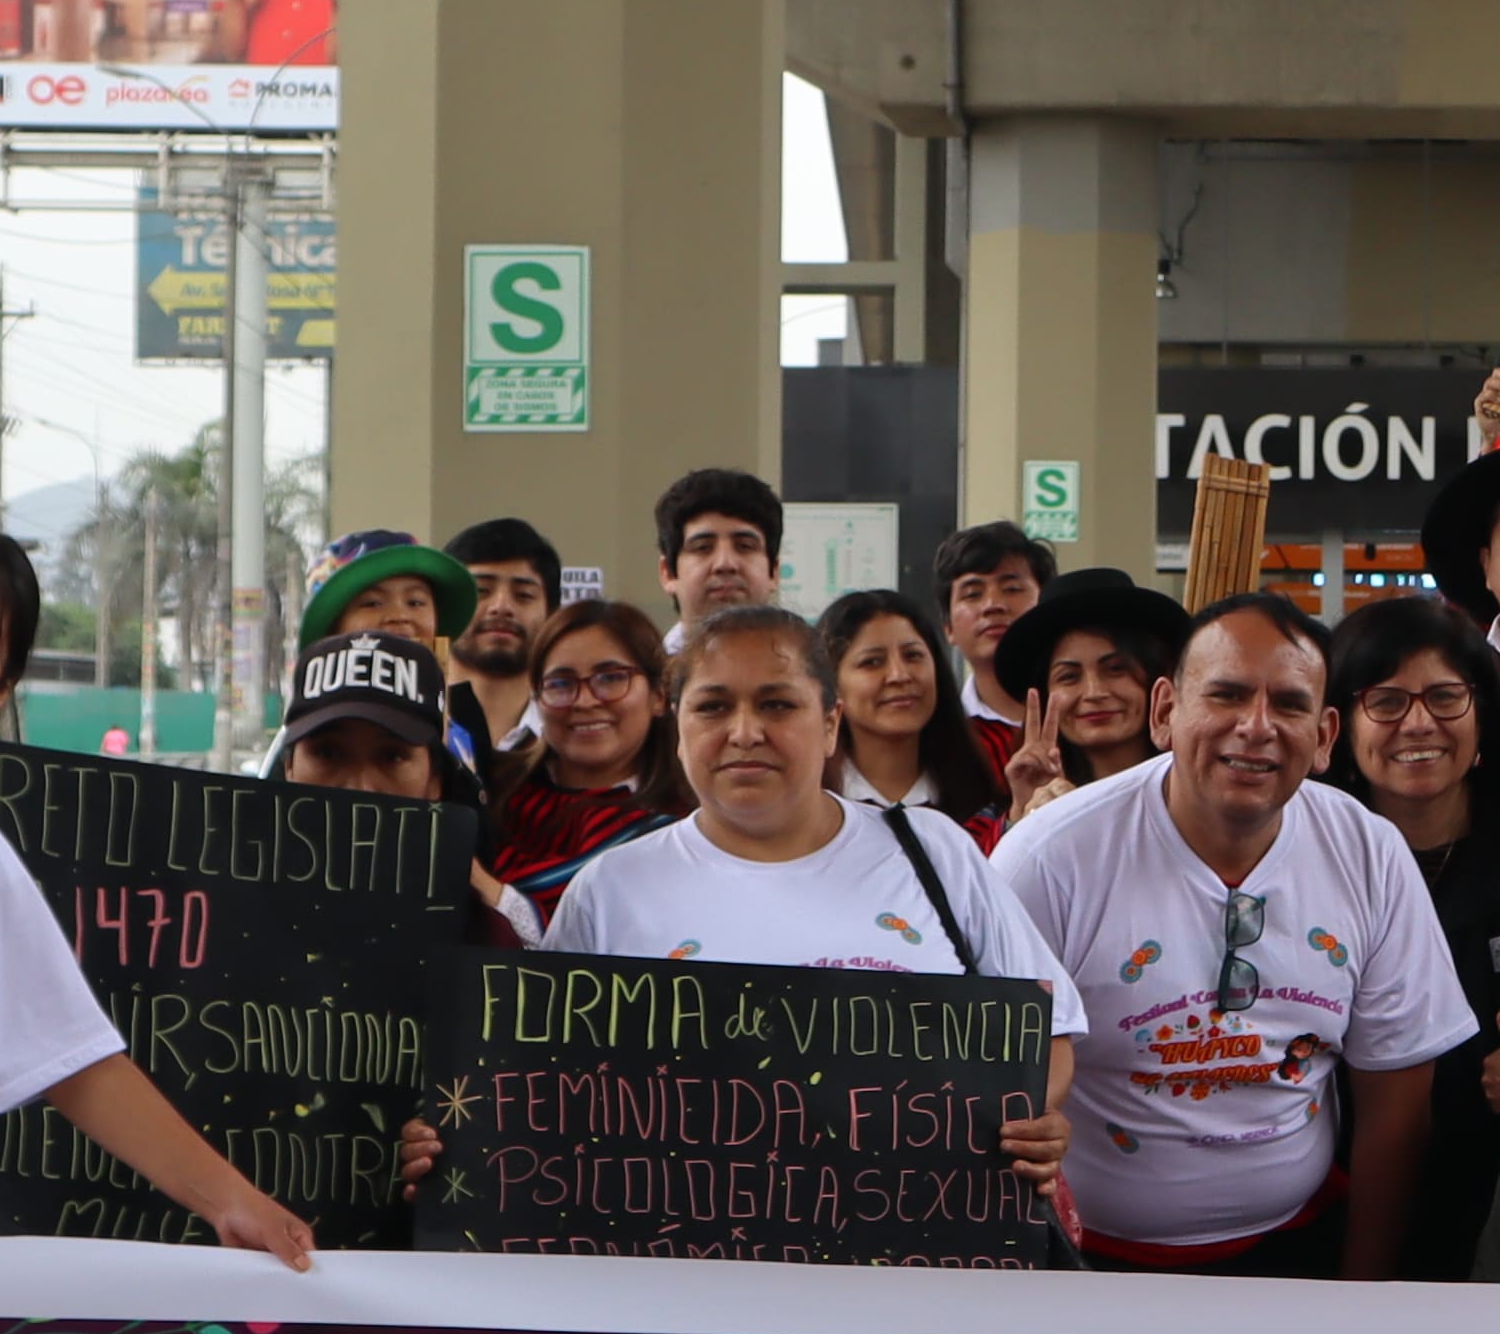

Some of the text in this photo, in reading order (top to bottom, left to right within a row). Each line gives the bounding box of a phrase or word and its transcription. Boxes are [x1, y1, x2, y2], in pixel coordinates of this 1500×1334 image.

[489, 261, 565, 355] S
[1155, 402, 1437, 482] TACIÓN
[1036, 469, 1067, 507] S
[75, 886, 210, 969] 1470
[483, 964, 709, 1050] FORMA
[781, 987, 1044, 1066] VIOLENCIA
[853, 1167, 1048, 1225] SEXUAL
